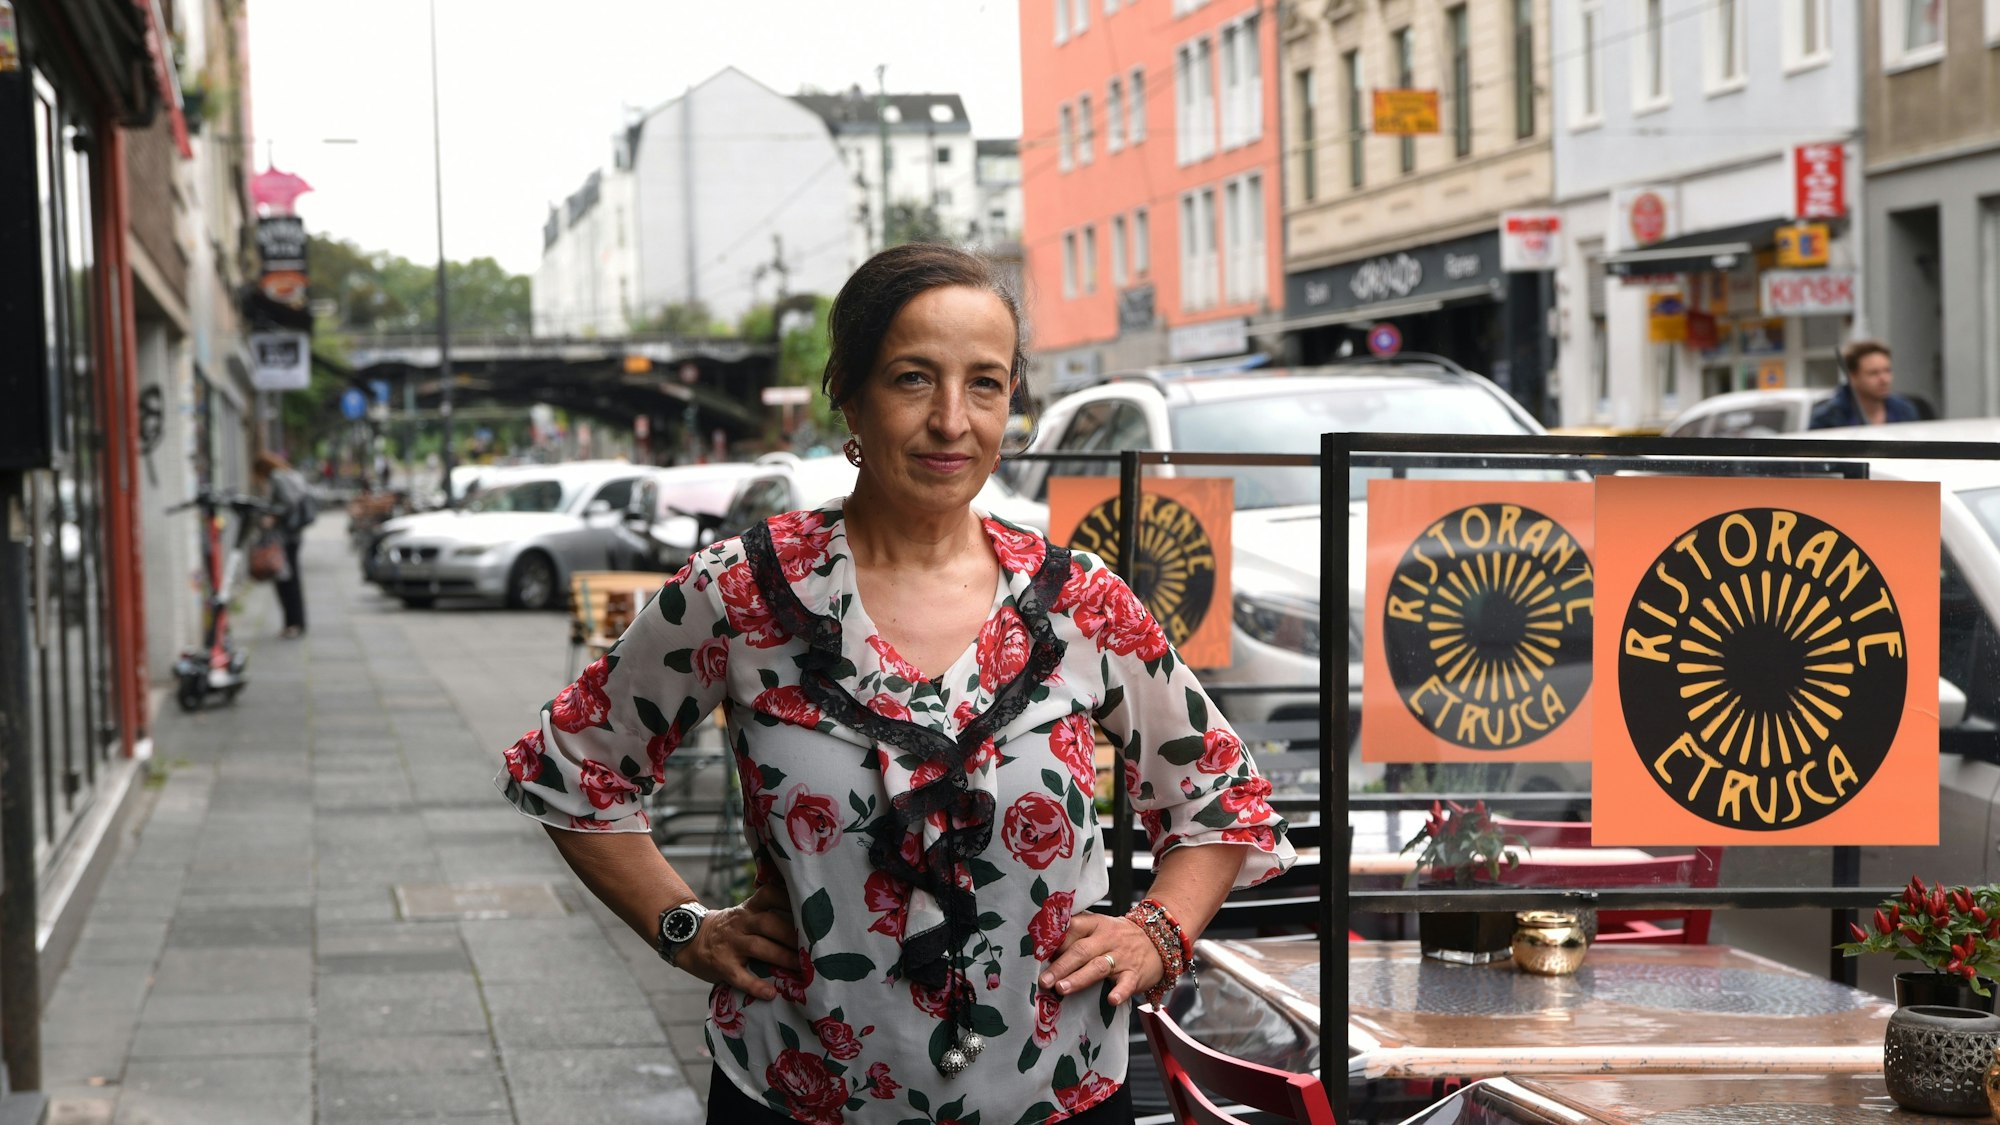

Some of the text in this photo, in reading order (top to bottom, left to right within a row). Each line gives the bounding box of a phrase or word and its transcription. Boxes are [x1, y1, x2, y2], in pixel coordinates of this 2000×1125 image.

[1388, 505, 1594, 625] RISTORANTE
[1625, 511, 1903, 667] RISTORANTE
[1409, 674, 1566, 745] ETRUSCA
[1654, 731, 1858, 824] ETRUSCA
